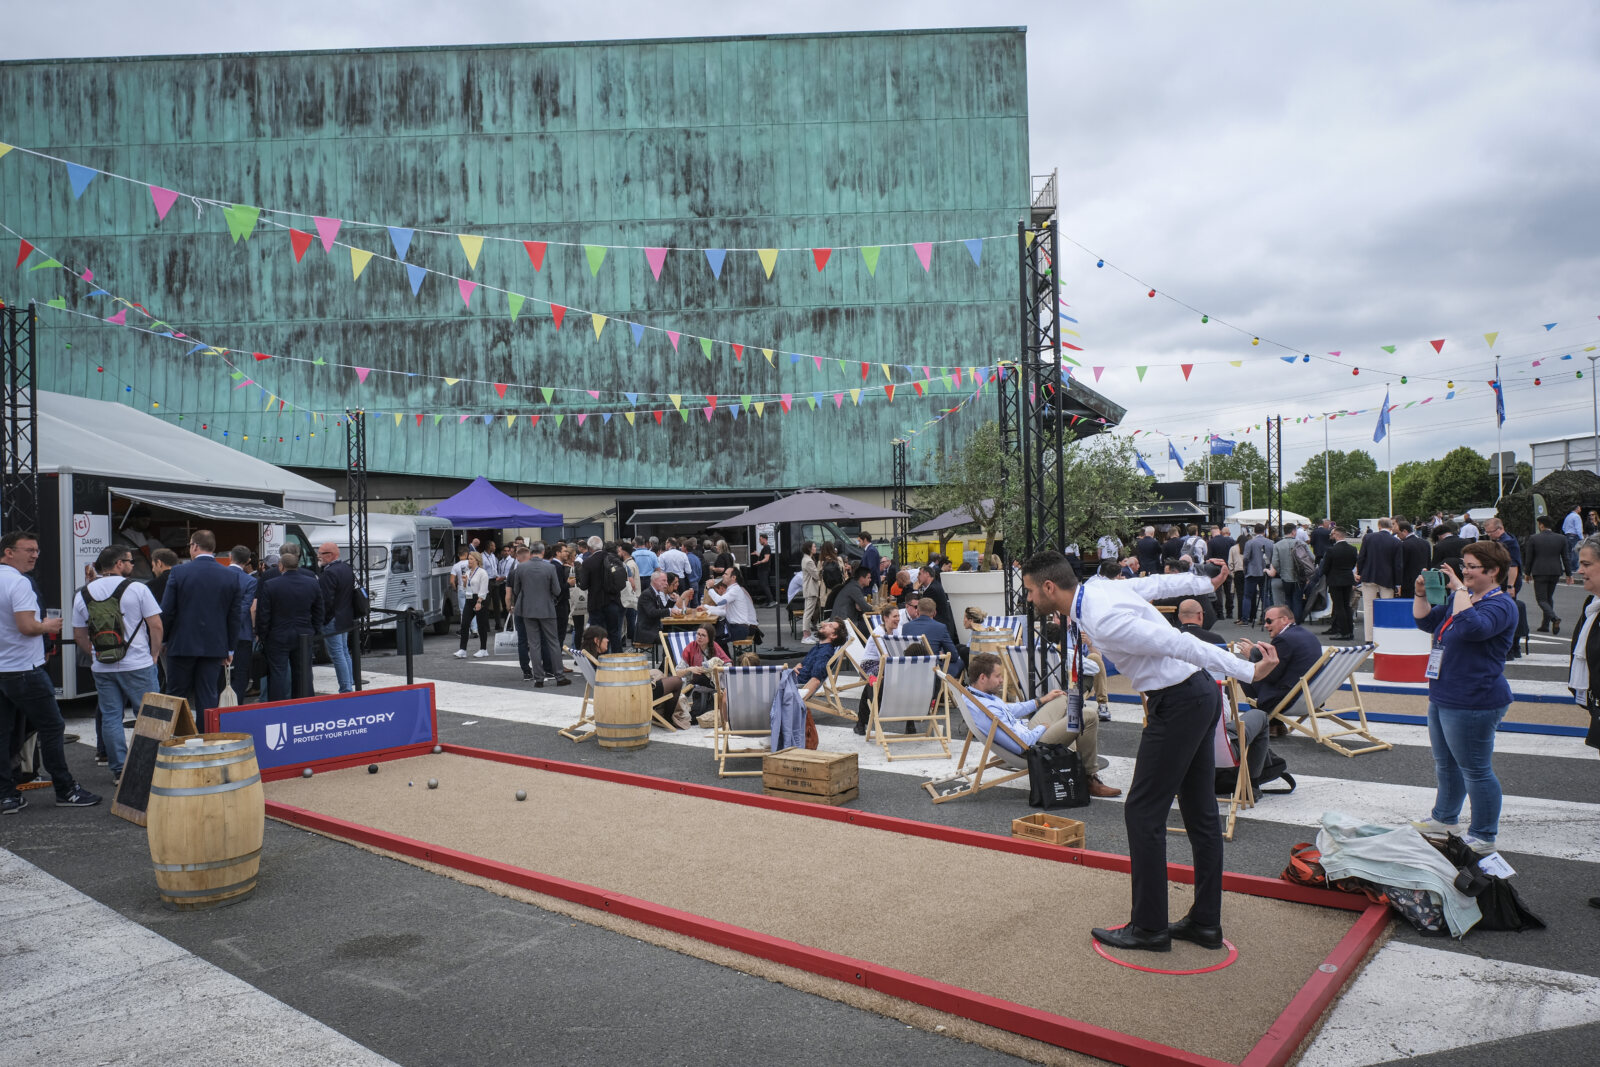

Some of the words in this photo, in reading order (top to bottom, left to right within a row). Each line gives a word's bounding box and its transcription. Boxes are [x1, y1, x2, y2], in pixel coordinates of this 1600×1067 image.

[75, 516, 87, 530] ici
[80, 546, 92, 554] HOT
[293, 712, 395, 735] EUROSATORY
[293, 733, 323, 744] PROTECT
[325, 730, 342, 739] YOUR
[345, 727, 367, 736] FUTURE
